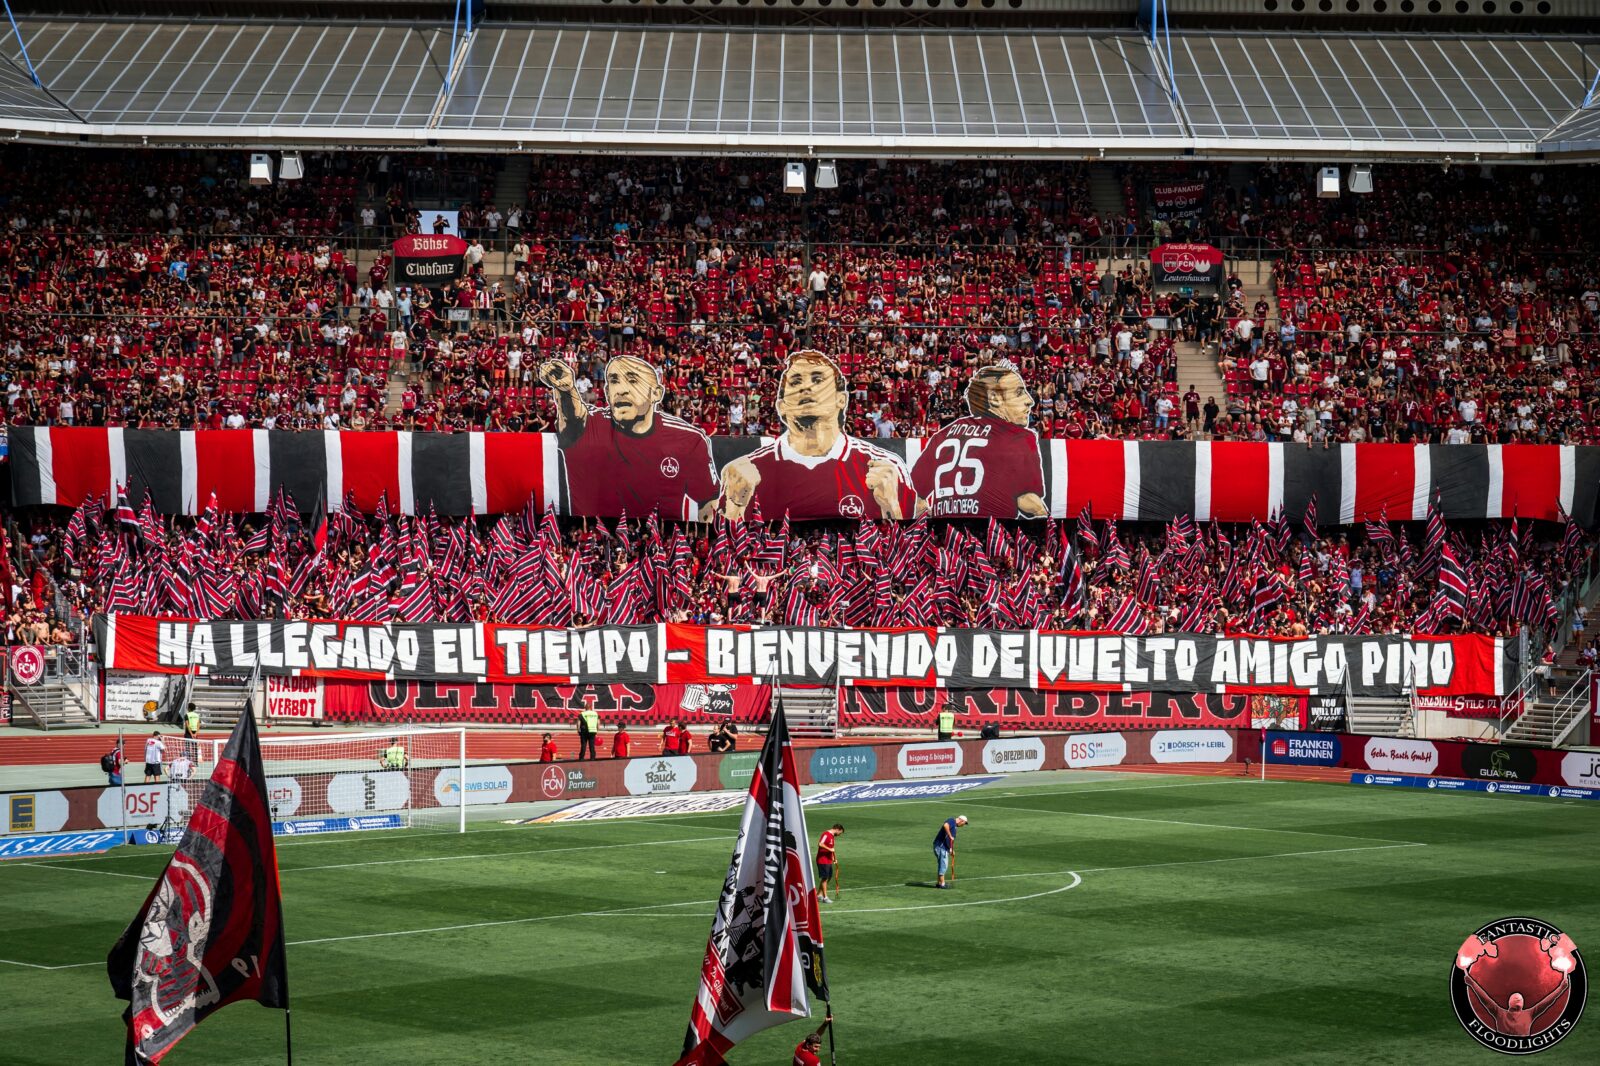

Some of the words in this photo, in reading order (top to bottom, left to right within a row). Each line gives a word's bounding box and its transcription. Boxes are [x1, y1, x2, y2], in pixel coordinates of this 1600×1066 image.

[412, 238, 448, 252] Böhse
[946, 423, 992, 438] PINOLA
[663, 465, 678, 474] FCN
[934, 437, 989, 498] 25
[841, 504, 862, 515] FCN
[158, 622, 217, 666] HA
[230, 622, 420, 671] LLEGADO
[433, 628, 486, 674] EL
[497, 630, 650, 674] TIEMPO
[707, 629, 958, 679] BIENVENIDO
[972, 634, 1024, 679] DE
[1040, 636, 1199, 683] VUELTO
[1211, 640, 1347, 686] AMIGO
[1362, 641, 1454, 687] PINO
[18, 662, 36, 674] FCN
[268, 674, 317, 693] STADION
[268, 697, 317, 718] VERBOT
[712, 700, 731, 709] 1994
[1321, 698, 1336, 707] YOU
[1289, 739, 1333, 750] FRANKEN
[1071, 742, 1096, 760] BSS
[1289, 748, 1333, 760] BRUNNEN
[820, 755, 867, 766] BIOGENA
[909, 754, 929, 763] bisping
[933, 752, 953, 762] bisping
[568, 771, 583, 780] Club
[829, 767, 858, 775] SPORTS
[1480, 768, 1518, 779] GUAMPA
[644, 770, 676, 784] Bauck
[483, 780, 508, 790] SOLAR
[543, 778, 563, 791] FCN
[568, 780, 596, 790] Partner
